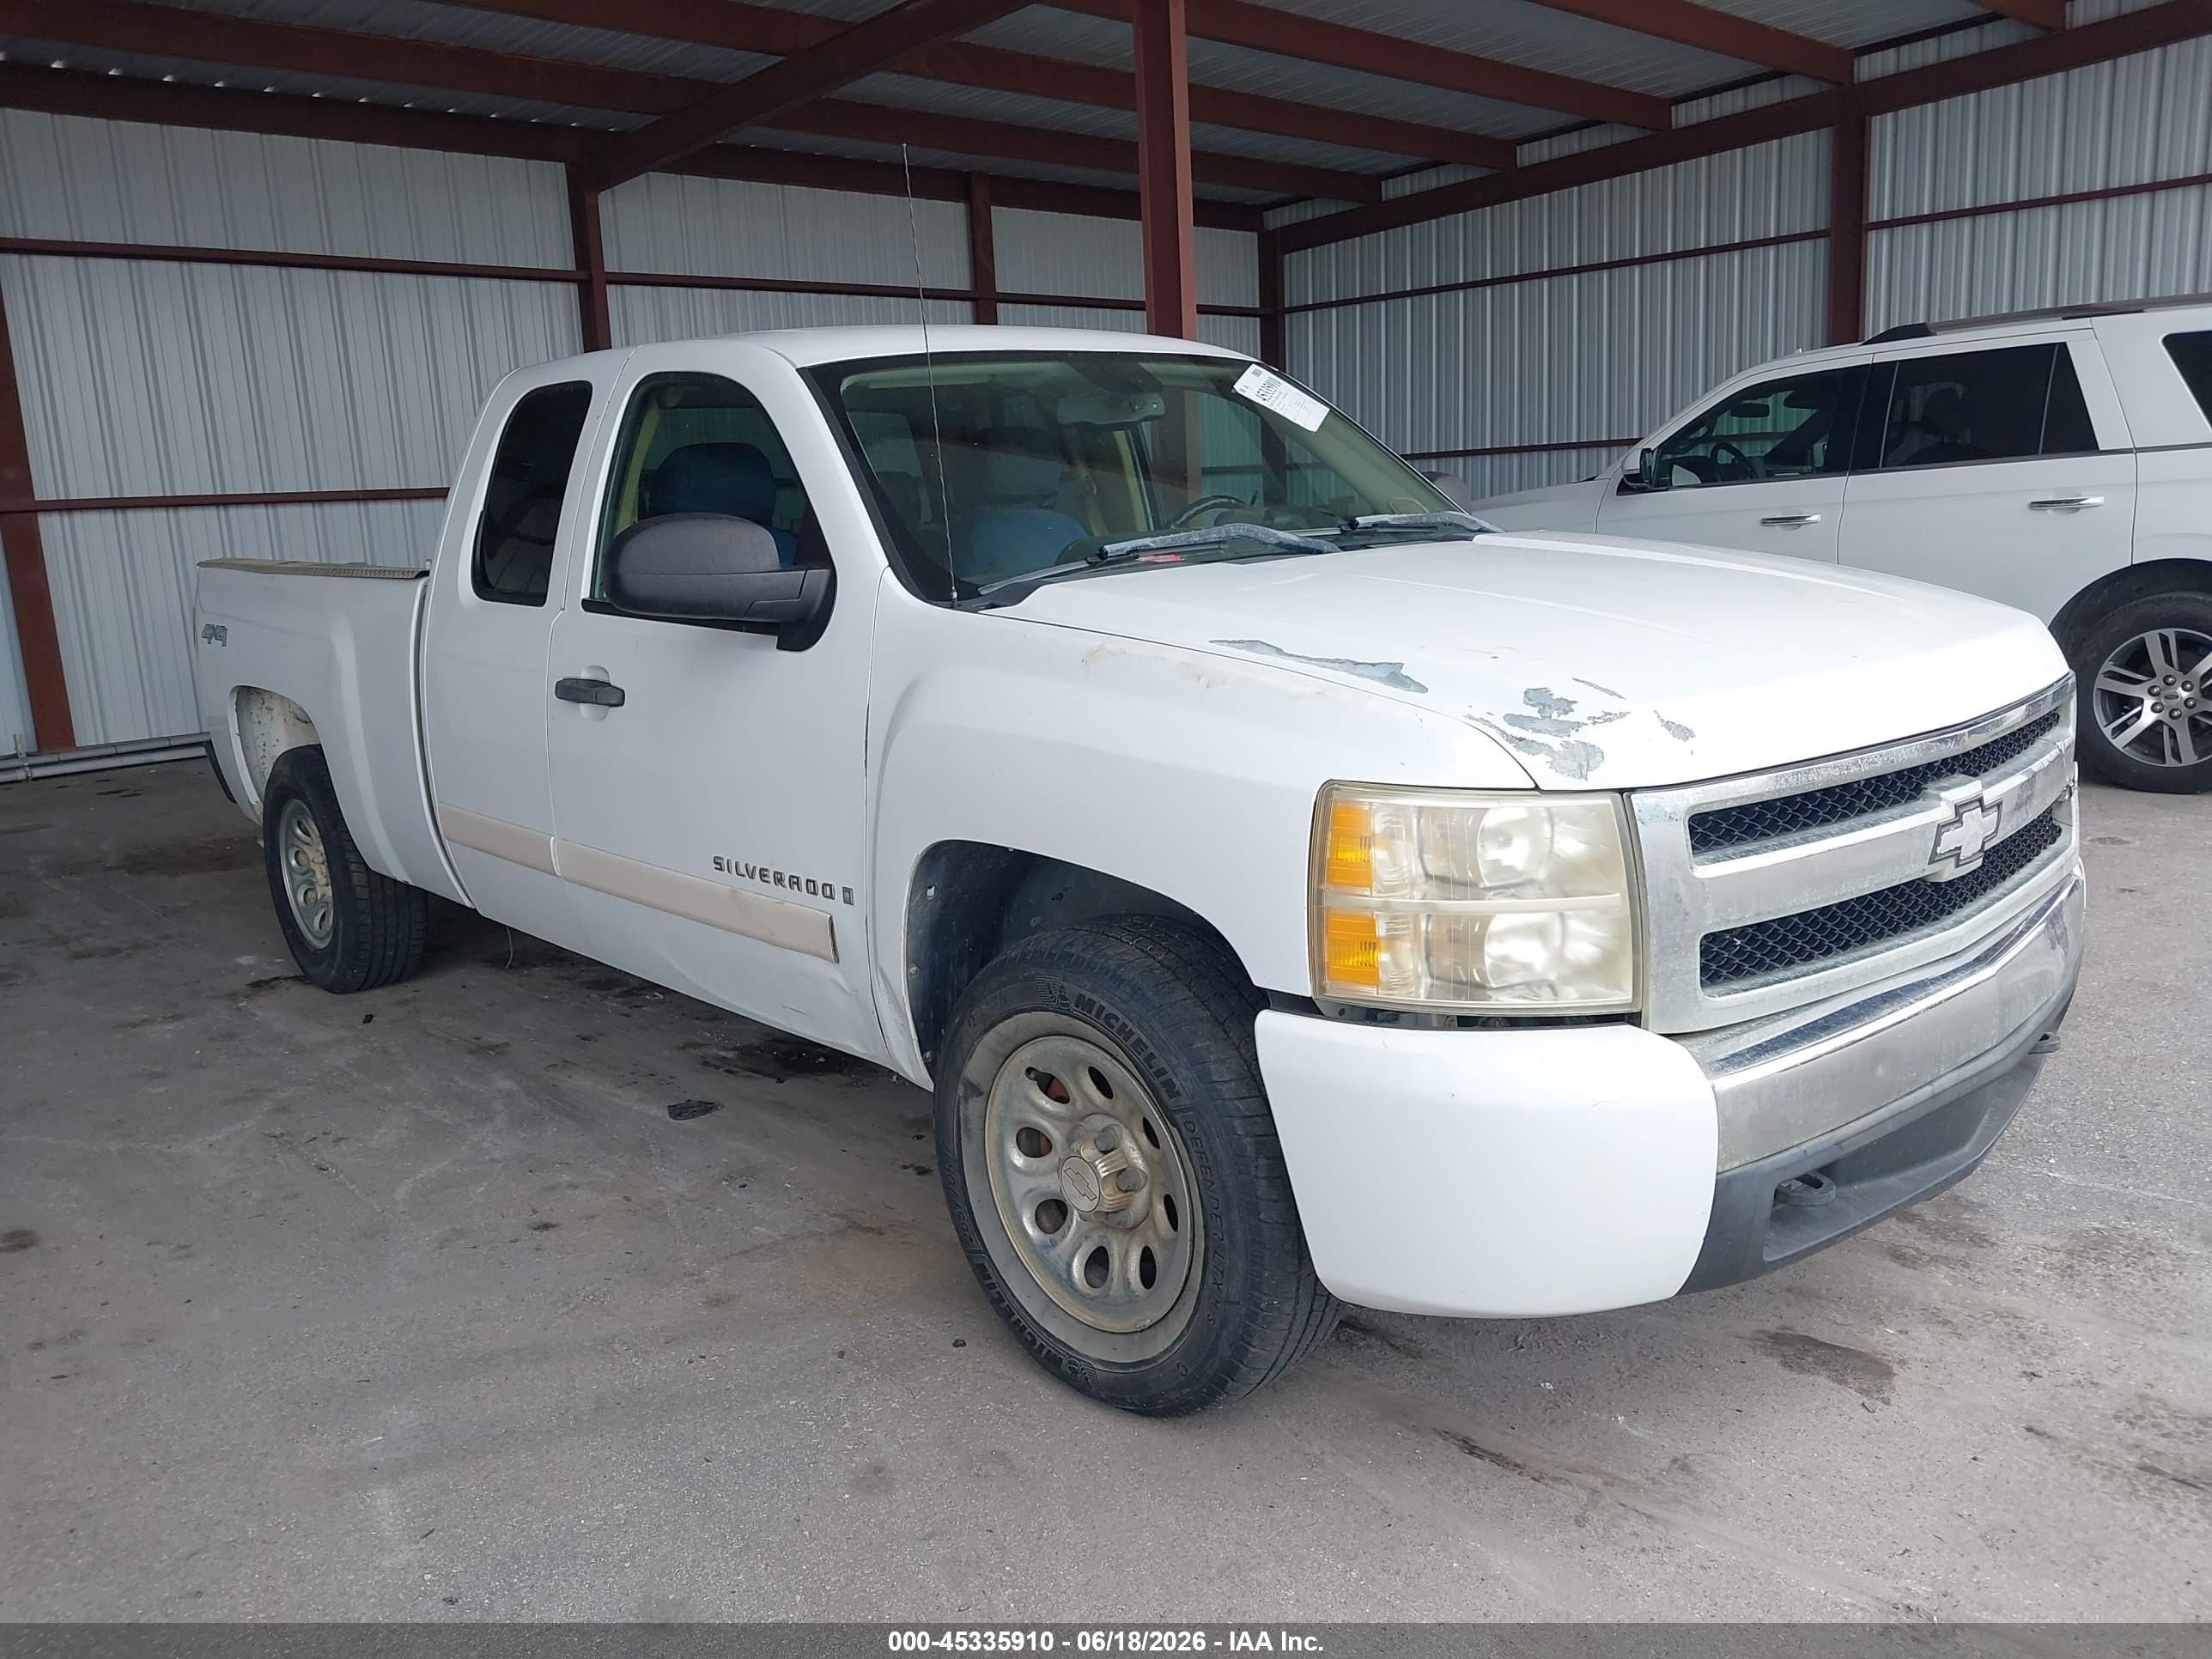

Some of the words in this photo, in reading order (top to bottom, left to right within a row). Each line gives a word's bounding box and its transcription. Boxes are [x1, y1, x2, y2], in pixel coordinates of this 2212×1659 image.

[713, 855, 836, 901] SILVERADO
[1074, 993, 1182, 1100] MICHELIN
[1184, 1119, 1224, 1243] DEFENDER
[1212, 1249, 1224, 1291] LTX
